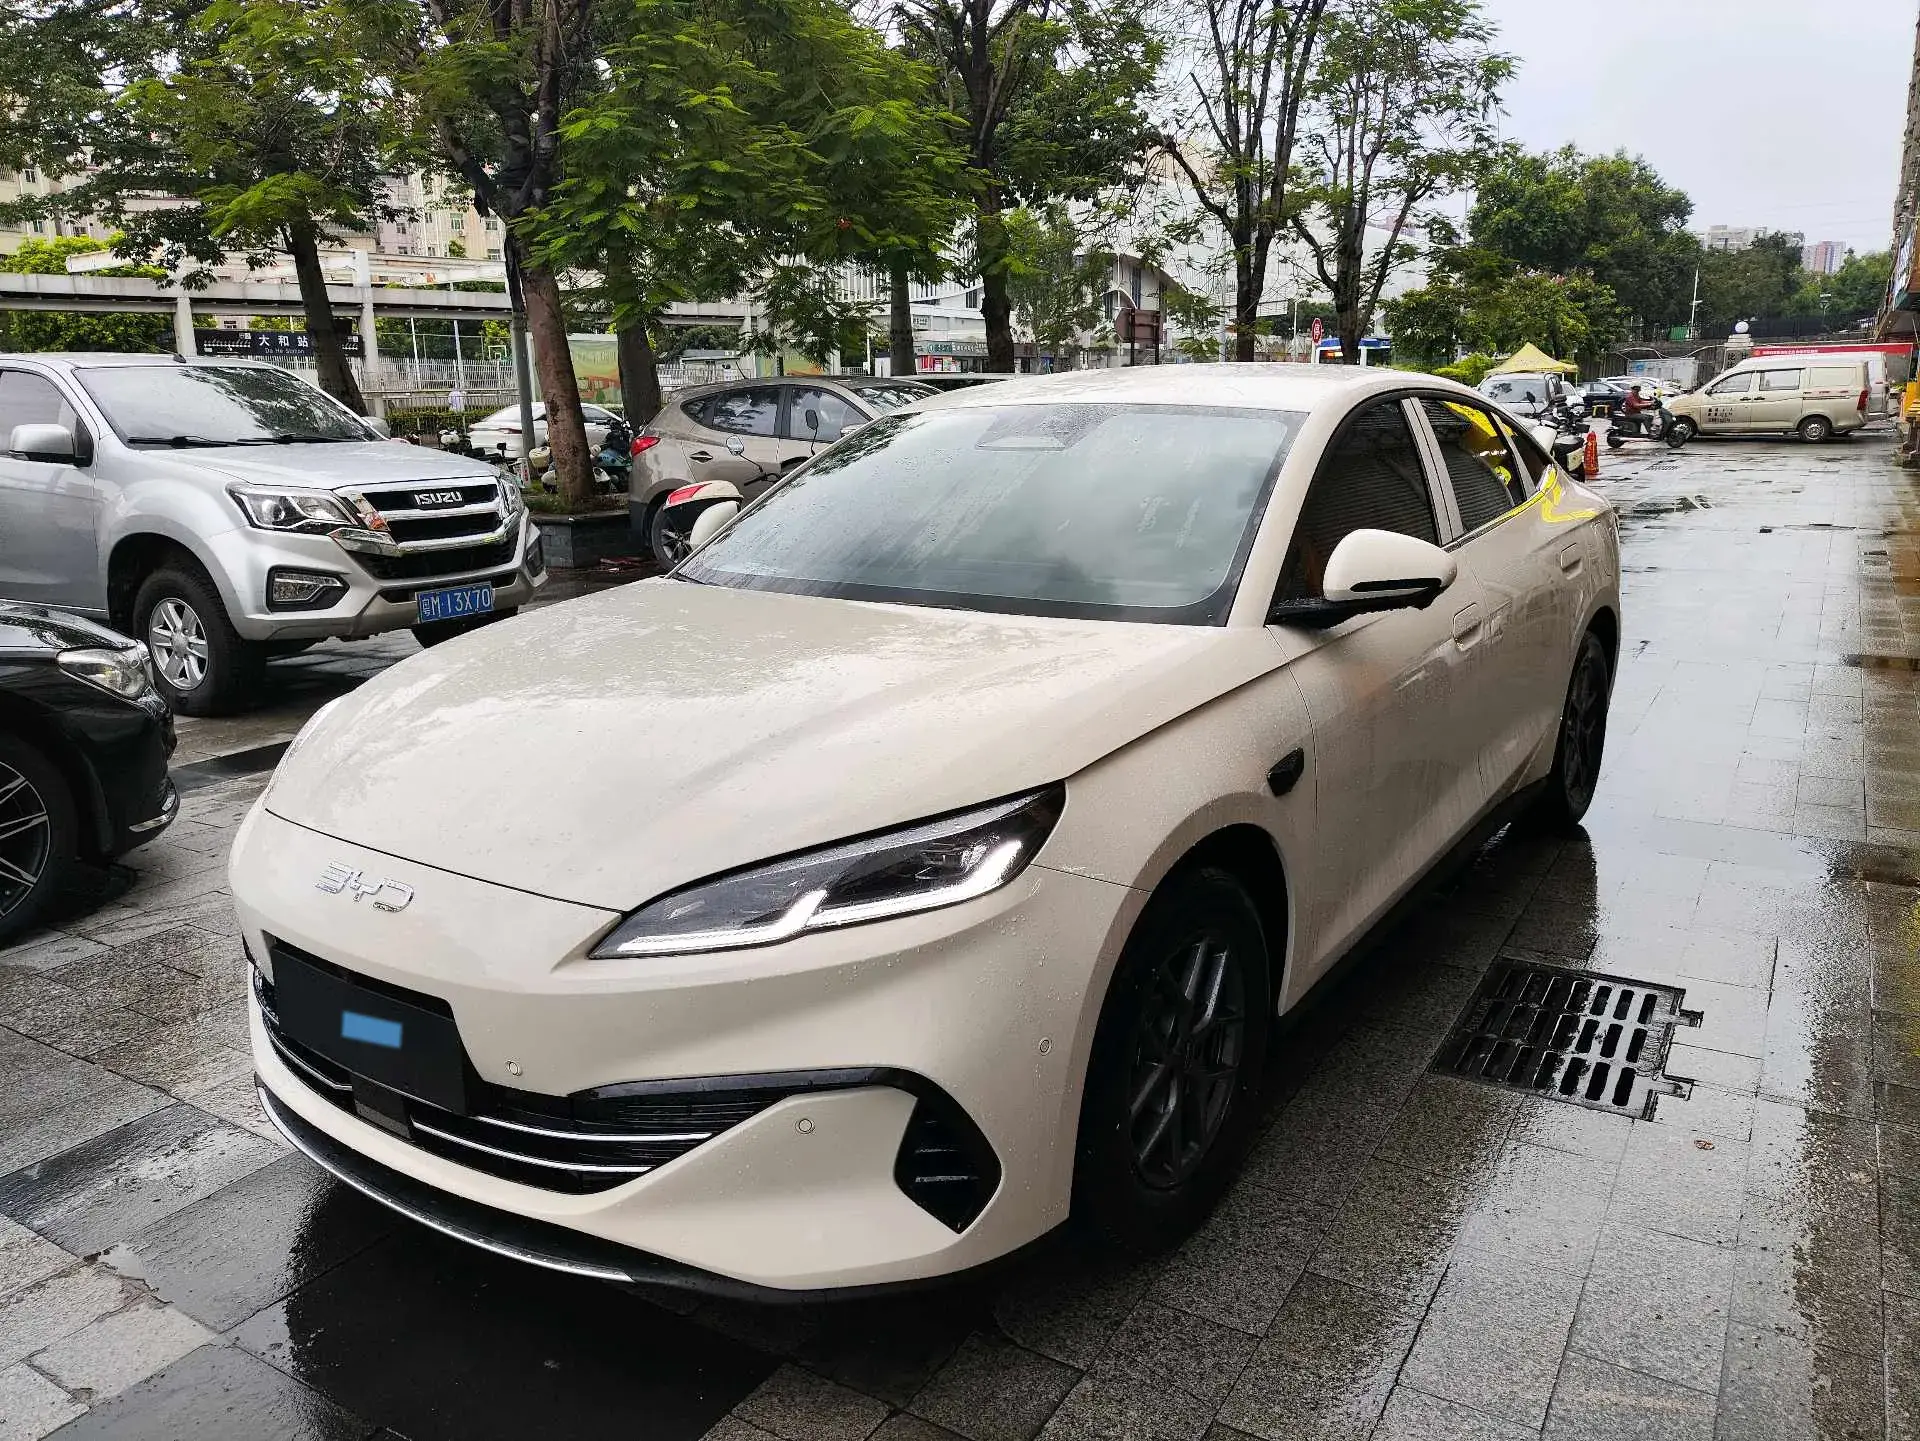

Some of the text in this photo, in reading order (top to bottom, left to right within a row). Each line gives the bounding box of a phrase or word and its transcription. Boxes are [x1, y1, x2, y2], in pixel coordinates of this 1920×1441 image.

[258, 334, 309, 348] 大和站
[414, 491, 463, 505] ISUZU
[314, 859, 414, 912] BYD
